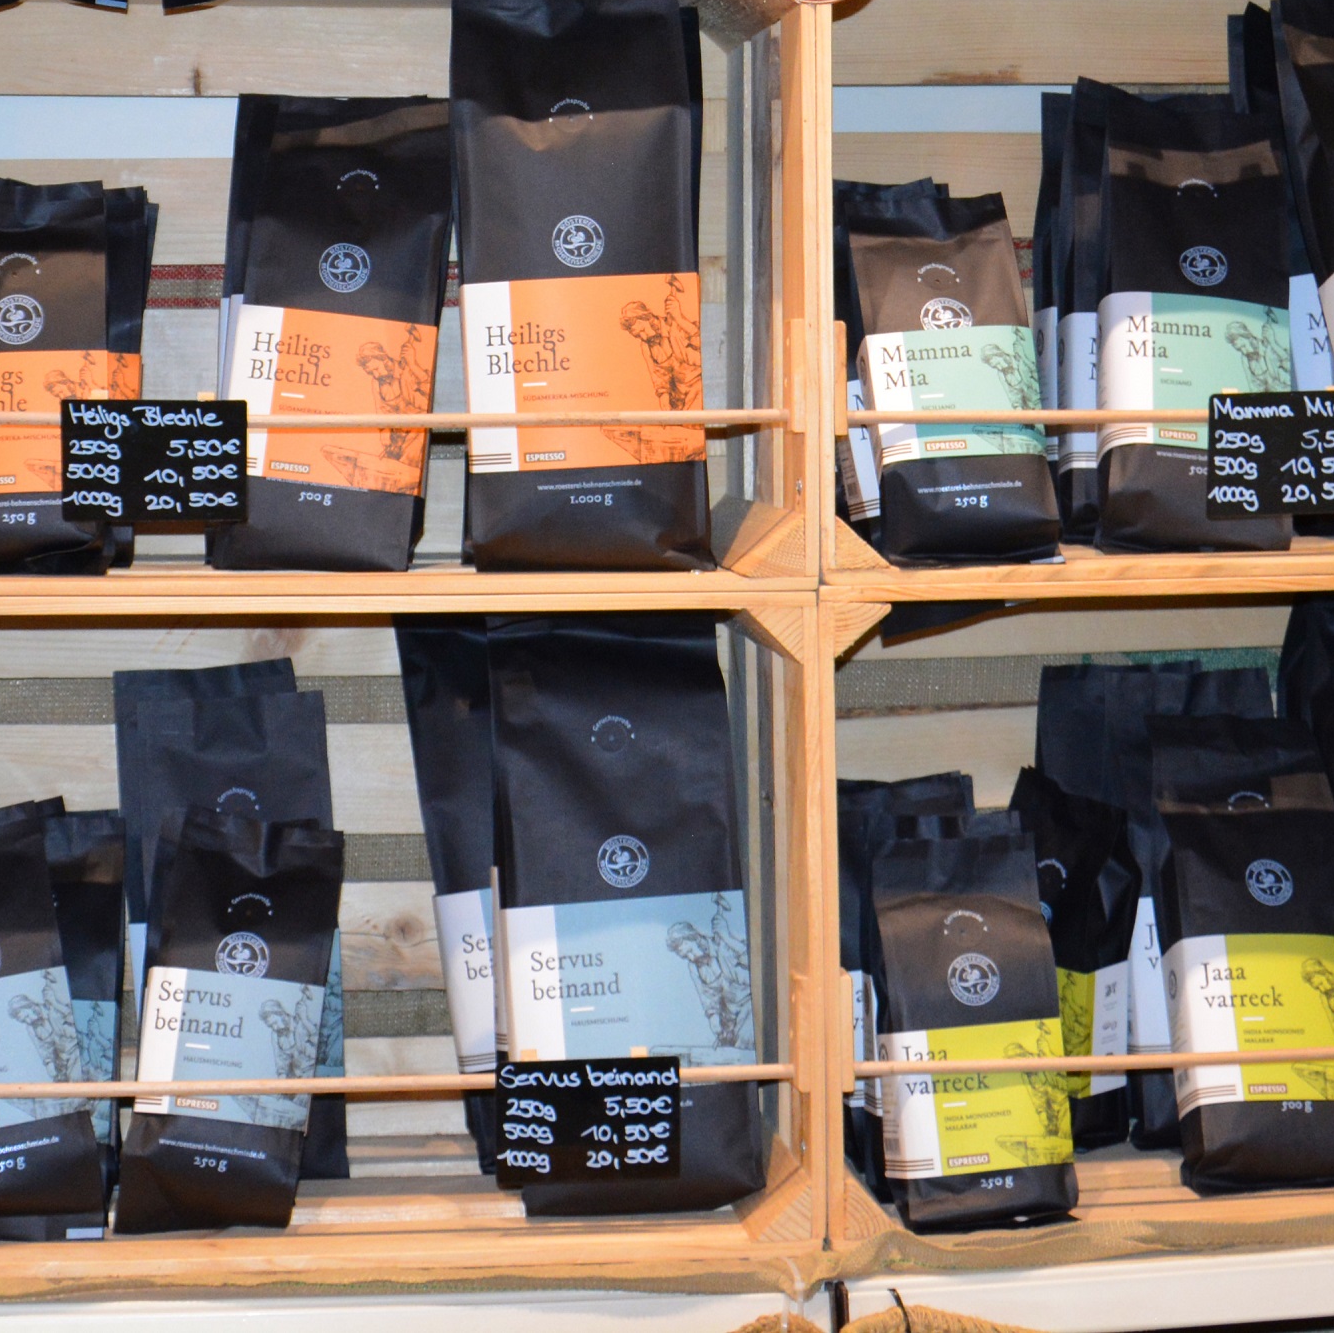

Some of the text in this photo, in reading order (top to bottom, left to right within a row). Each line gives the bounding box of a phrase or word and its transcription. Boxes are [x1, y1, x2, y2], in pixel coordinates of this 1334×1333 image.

[485, 325, 566, 349] Heiligs
[1126, 314, 1212, 339] Mamma
[254, 331, 332, 361] Heiligs
[880, 345, 972, 365] Mamma
[1127, 339, 1168, 359] Mia
[248, 359, 332, 387] Blechle
[487, 351, 571, 376] Blechle
[883, 370, 929, 390] Mia
[69, 403, 131, 439] Heiligs
[1212, 397, 1294, 422] Mamma
[69, 439, 241, 460] 250g 5,50€
[926, 441, 966, 451] ESPRESSO
[1214, 429, 1265, 453] 250g
[526, 452, 565, 462] ESPRESSO
[530, 950, 604, 972] Servus
[532, 973, 622, 1001] beinand
[1200, 962, 1247, 989] Jaaa
[158, 981, 232, 1007] Servus
[1204, 985, 1283, 1009] varreck
[154, 1010, 244, 1039] beinand
[498, 1065, 679, 1088] Servus beinand
[905, 1071, 990, 1096] varreck
[177, 1098, 217, 1110] ESPRESSO
[505, 1095, 673, 1122] 250g 5,50€
[948, 1155, 989, 1166] ESPRESSO
